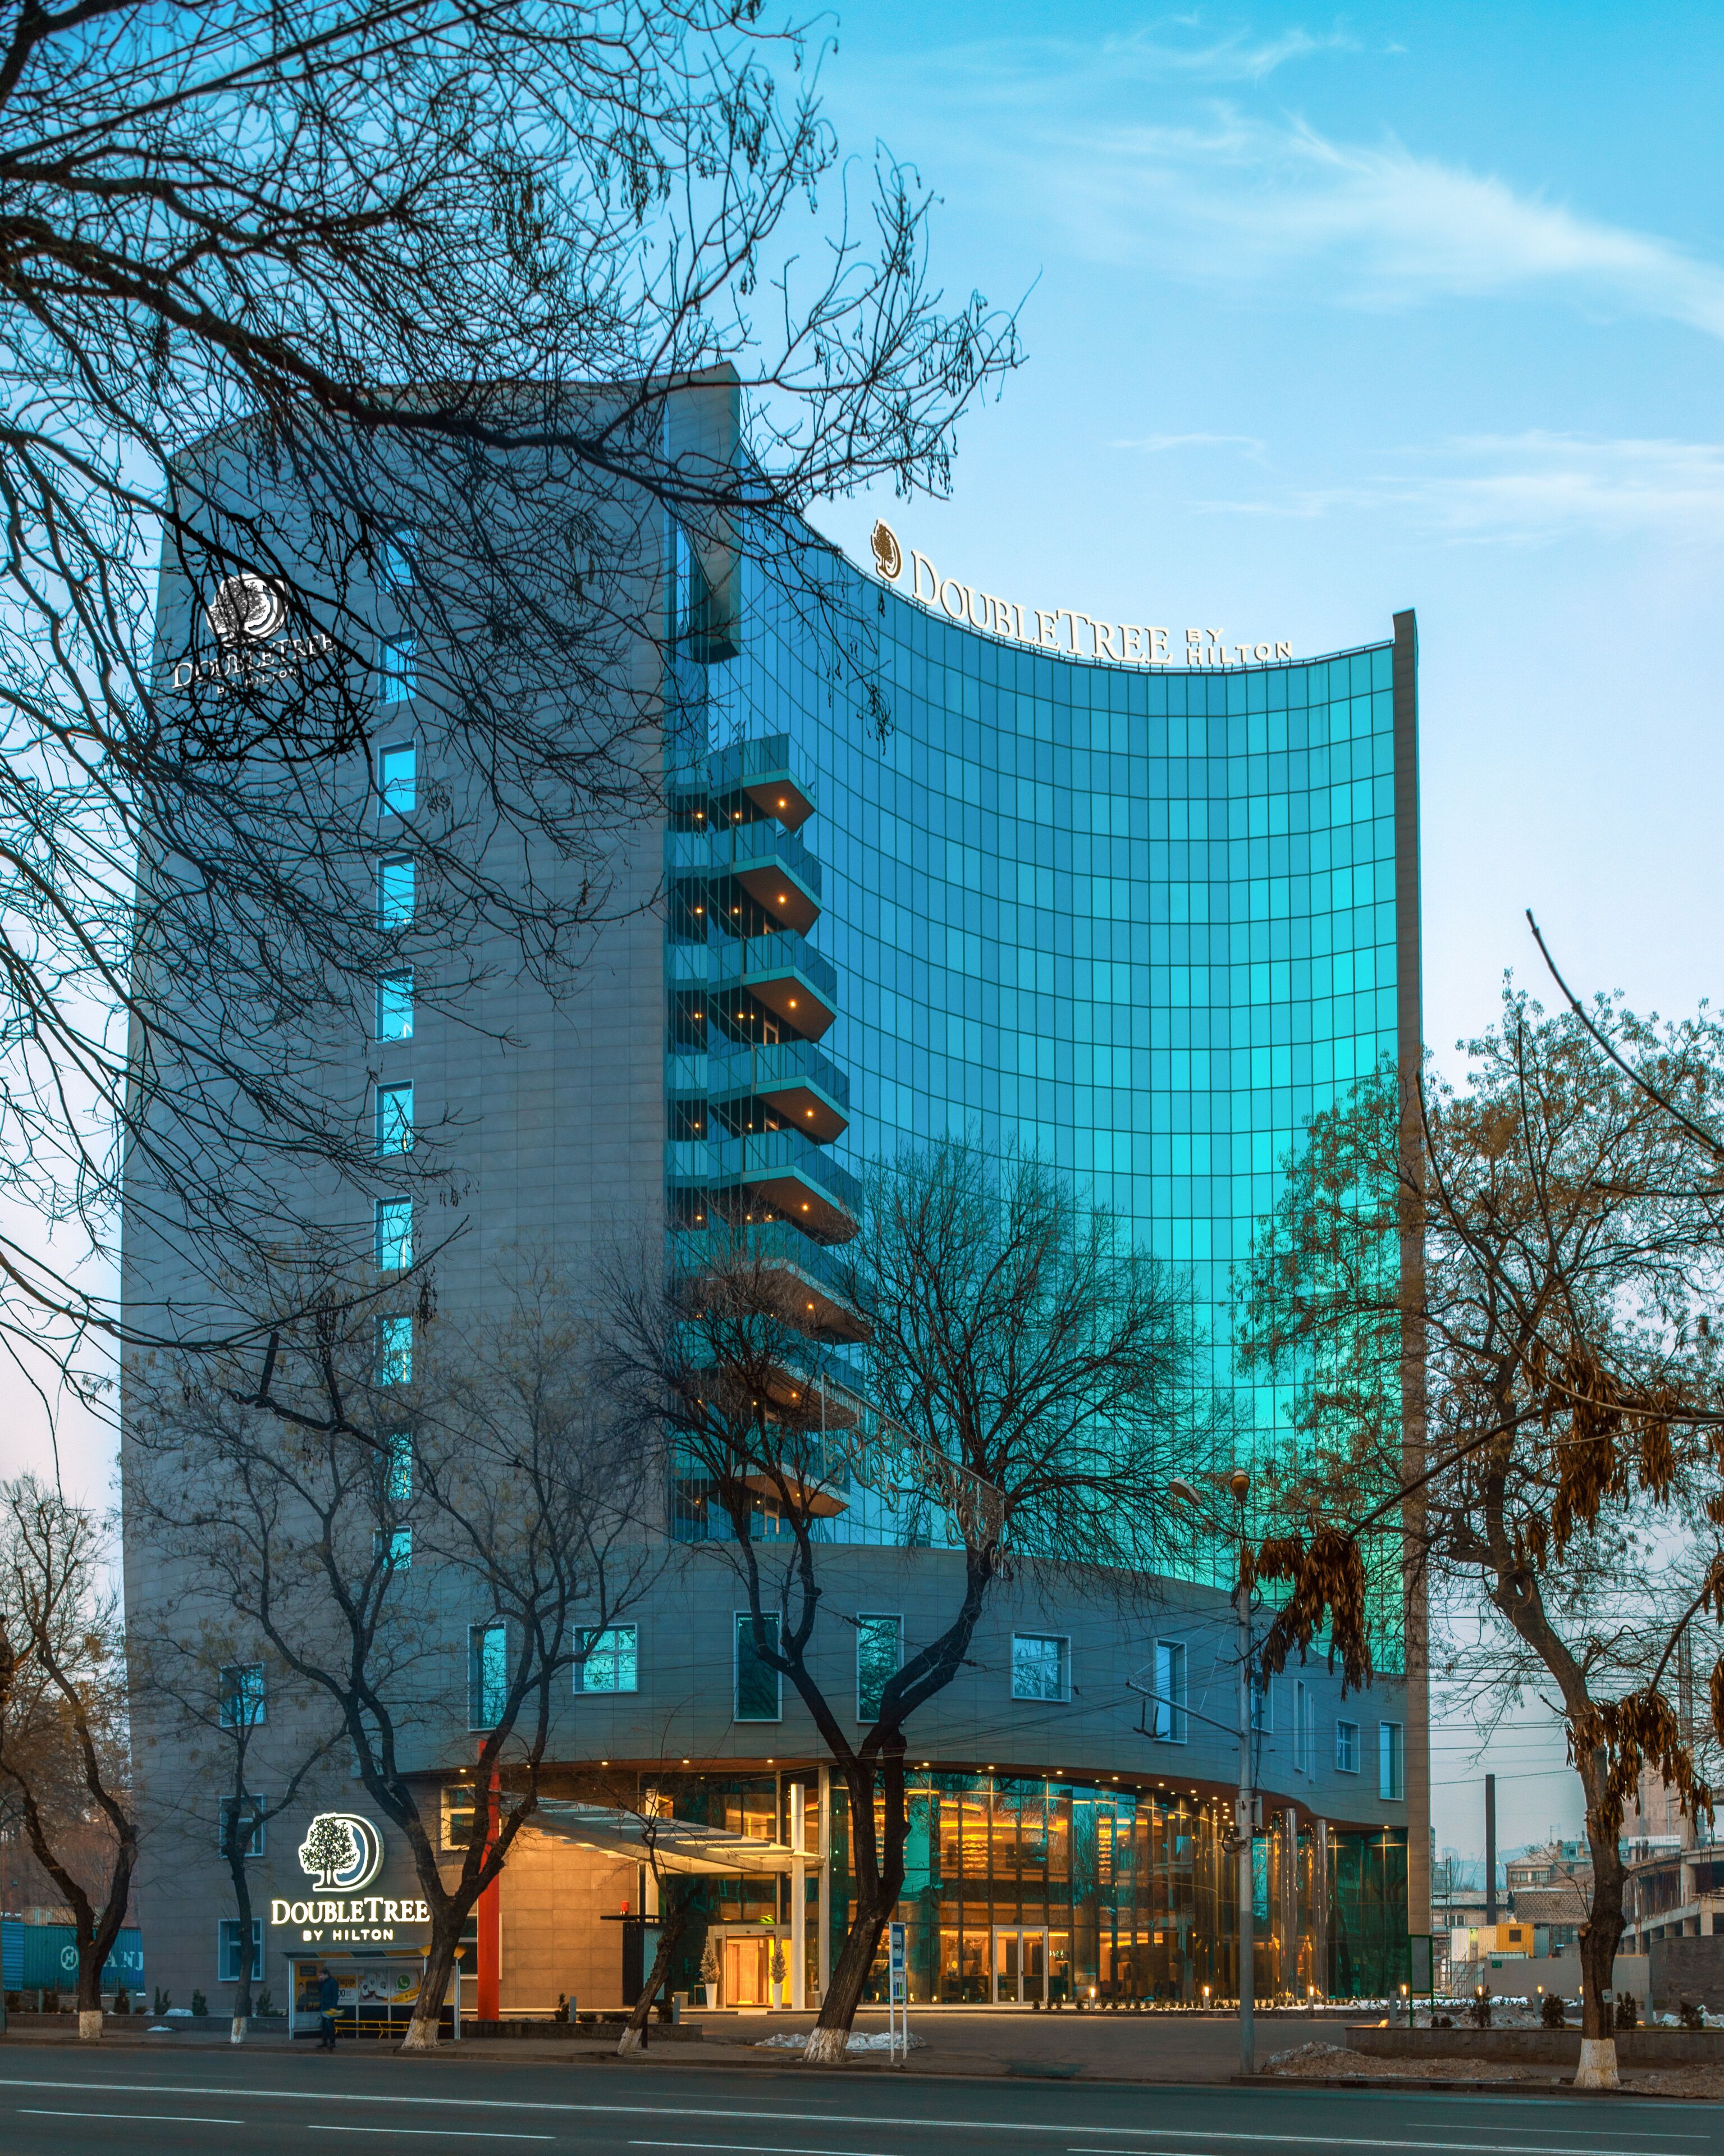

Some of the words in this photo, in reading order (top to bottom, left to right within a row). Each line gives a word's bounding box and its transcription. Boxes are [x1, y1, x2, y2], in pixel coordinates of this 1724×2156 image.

[911, 549, 1173, 665] DOUBLETREE
[1186, 628, 1224, 642] BY
[1187, 641, 1292, 665] HILTON
[271, 1897, 430, 1924] DOUBLETREE
[303, 1930, 323, 1941] BY
[332, 1929, 394, 1941] HILTON
